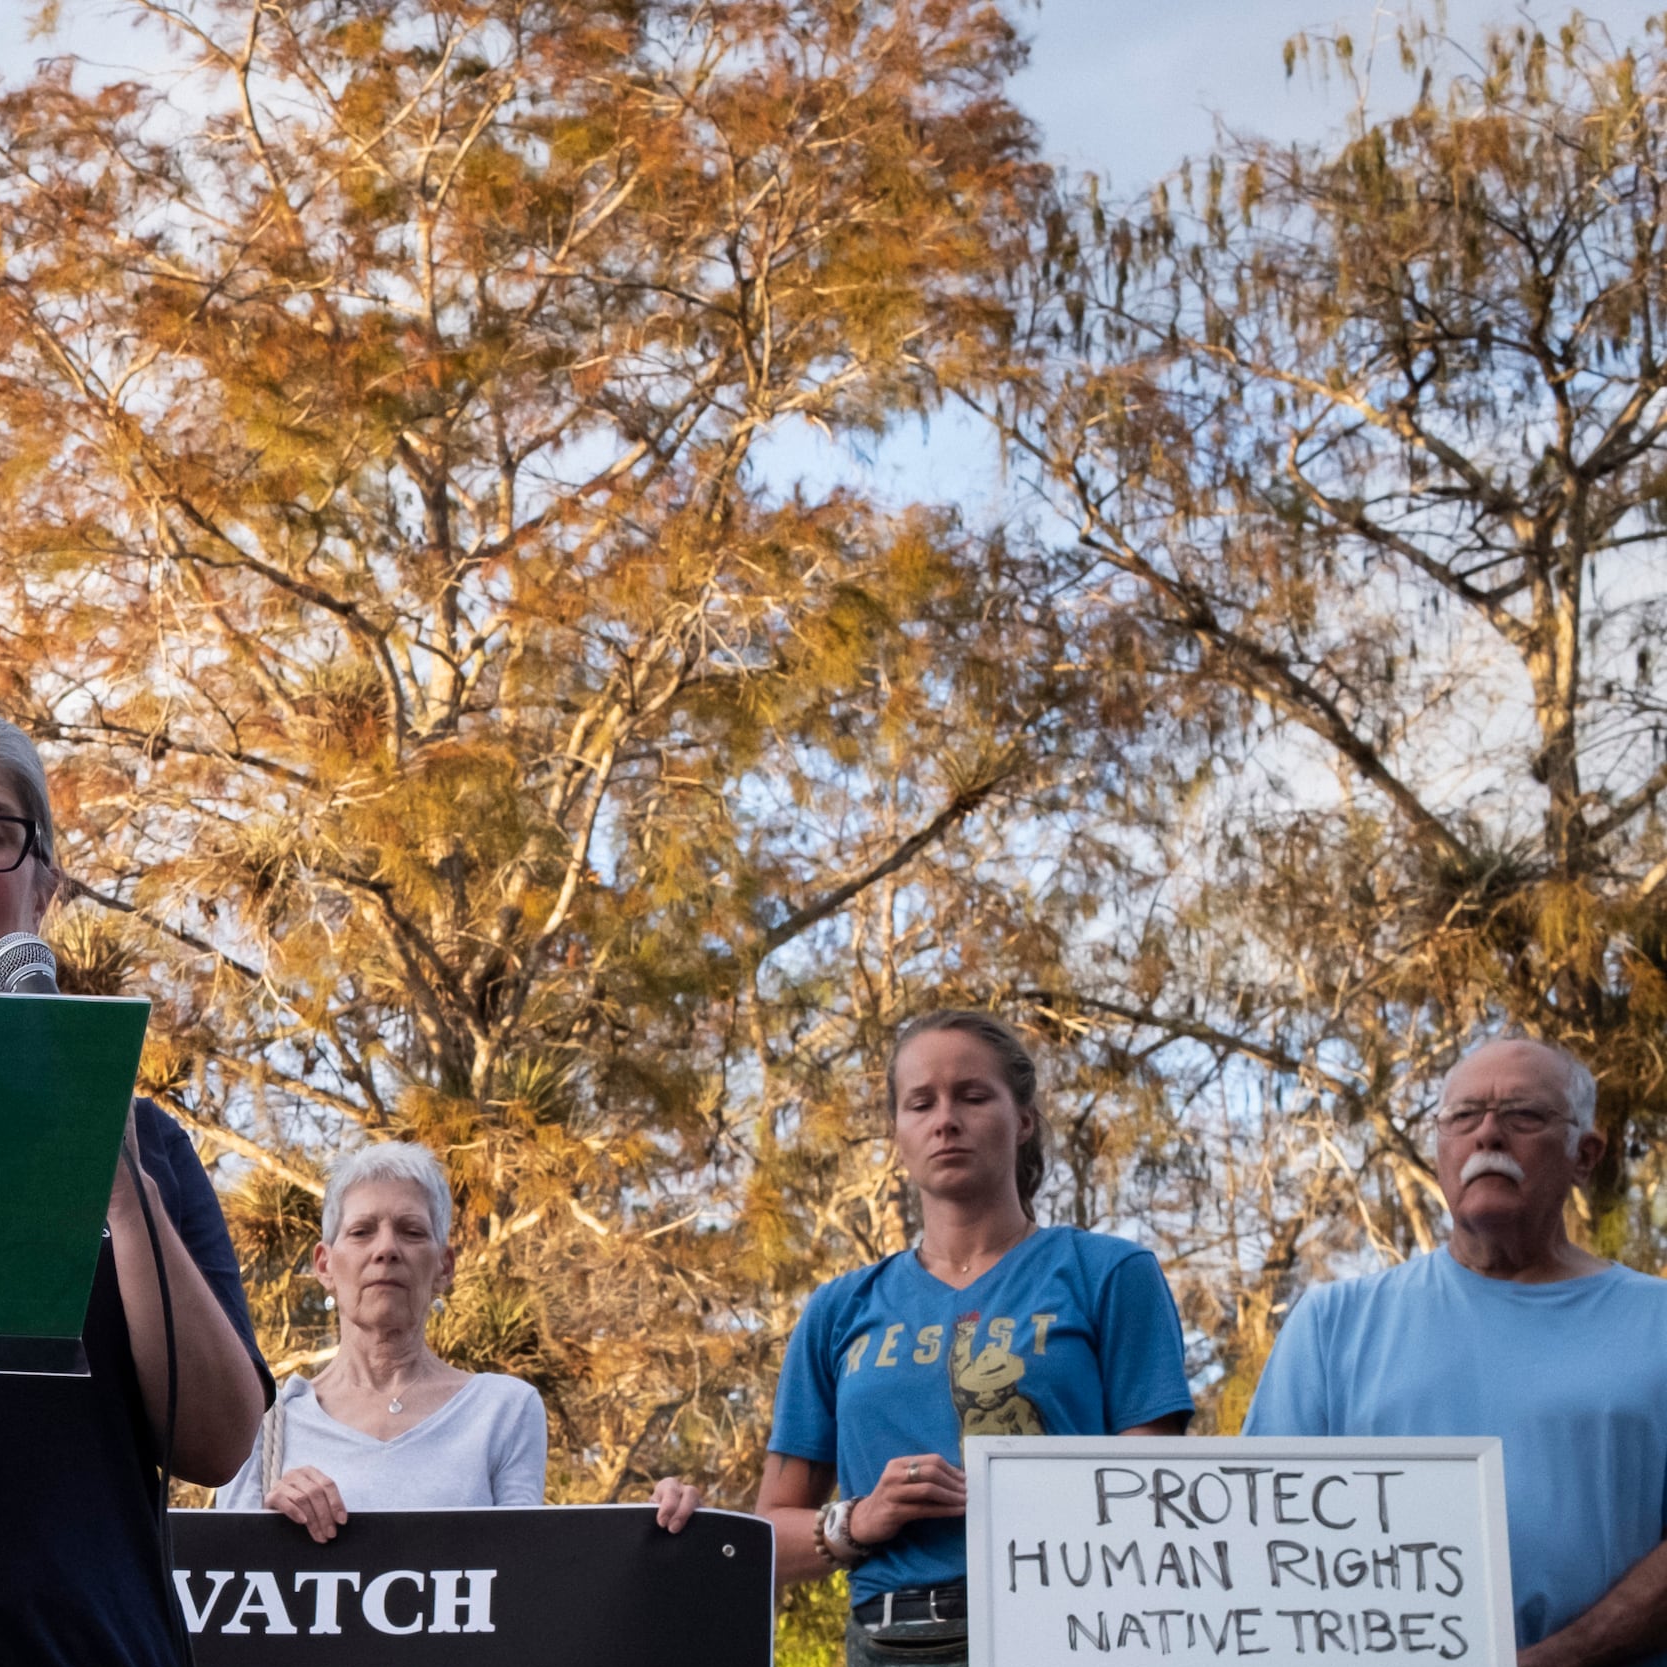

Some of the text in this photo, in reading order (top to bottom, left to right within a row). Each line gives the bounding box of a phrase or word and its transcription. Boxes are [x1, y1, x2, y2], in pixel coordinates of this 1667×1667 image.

[1095, 1467, 1403, 1531] PROTECT
[1008, 1540, 1465, 1597] HUMAN RIGHTS
[1068, 1609, 1469, 1660] NATIVE TRIBES
